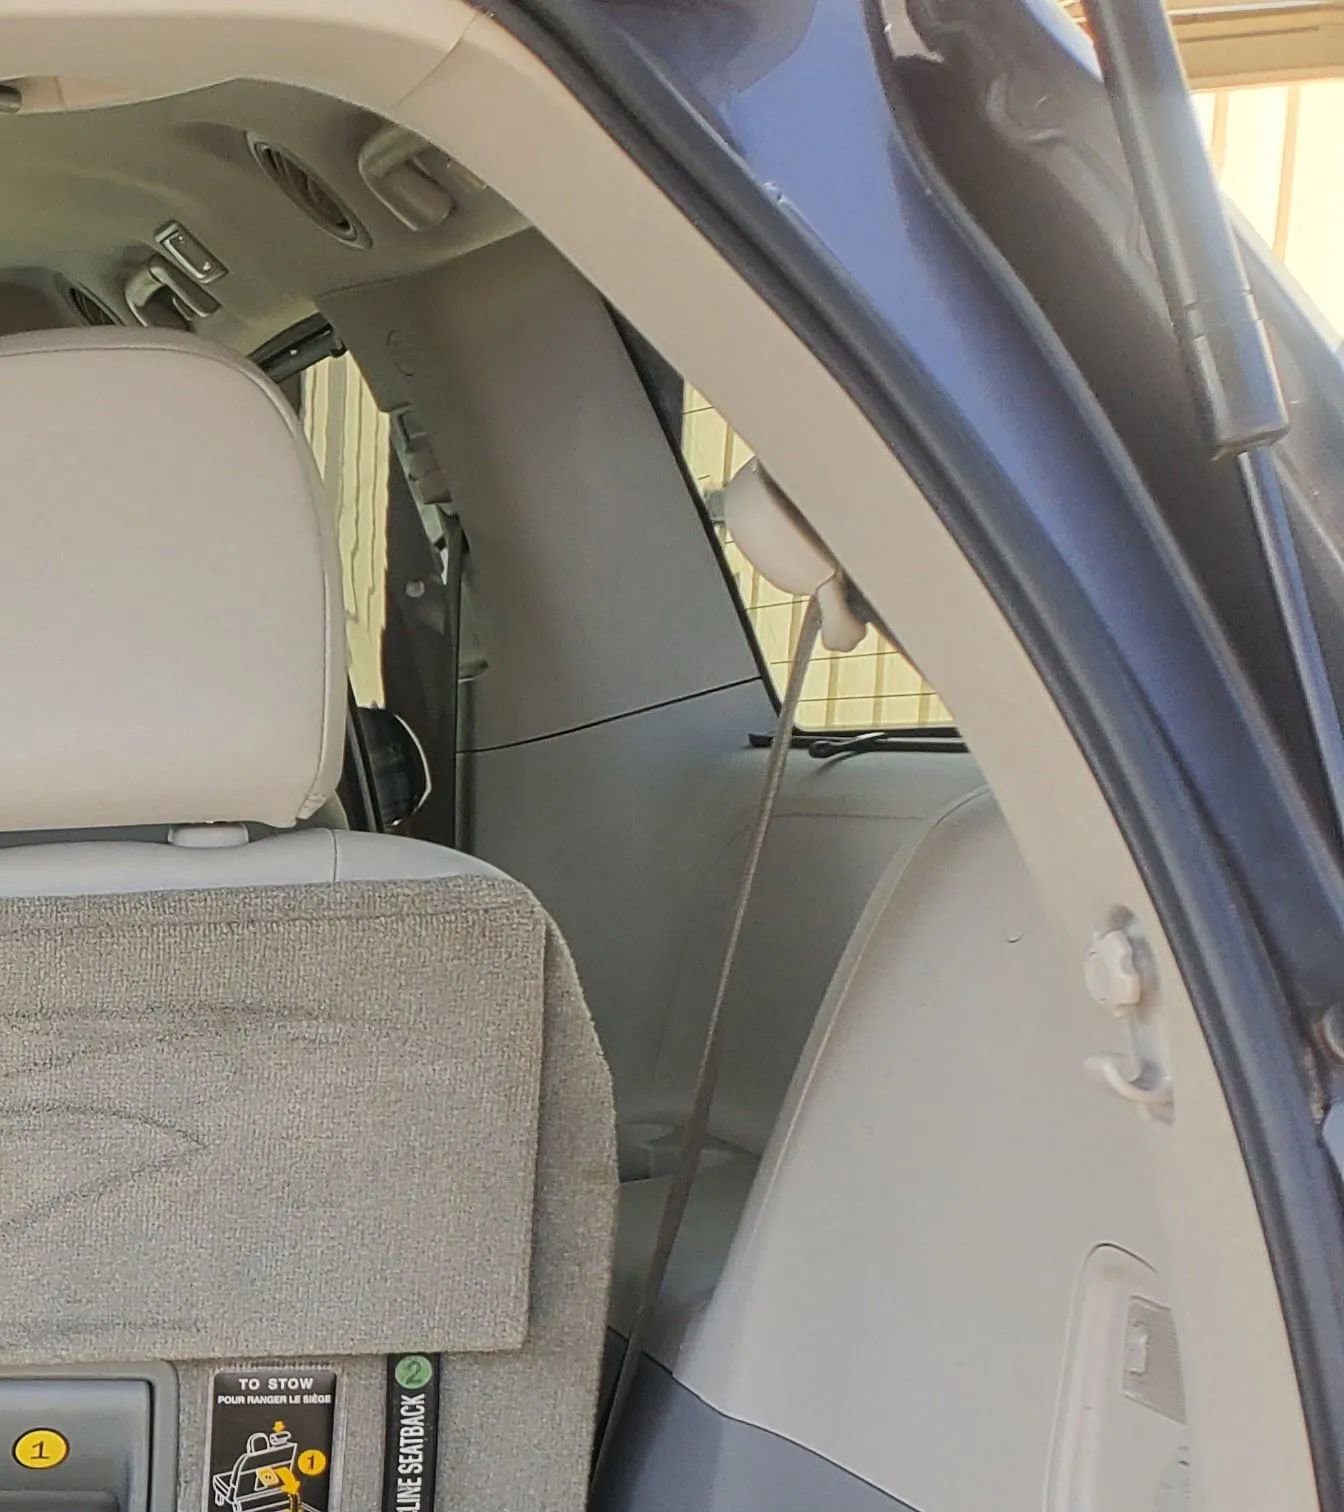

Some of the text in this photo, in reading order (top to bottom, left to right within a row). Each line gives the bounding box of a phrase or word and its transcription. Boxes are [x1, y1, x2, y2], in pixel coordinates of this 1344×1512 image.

[406, 1361, 421, 1384] 2
[239, 1378, 313, 1390] TO STOW
[218, 1396, 245, 1404] POUR
[247, 1395, 287, 1404] RANGER
[289, 1395, 300, 1404] LE
[398, 1394, 426, 1473] SEATBACK
[31, 1441, 49, 1459] 1
